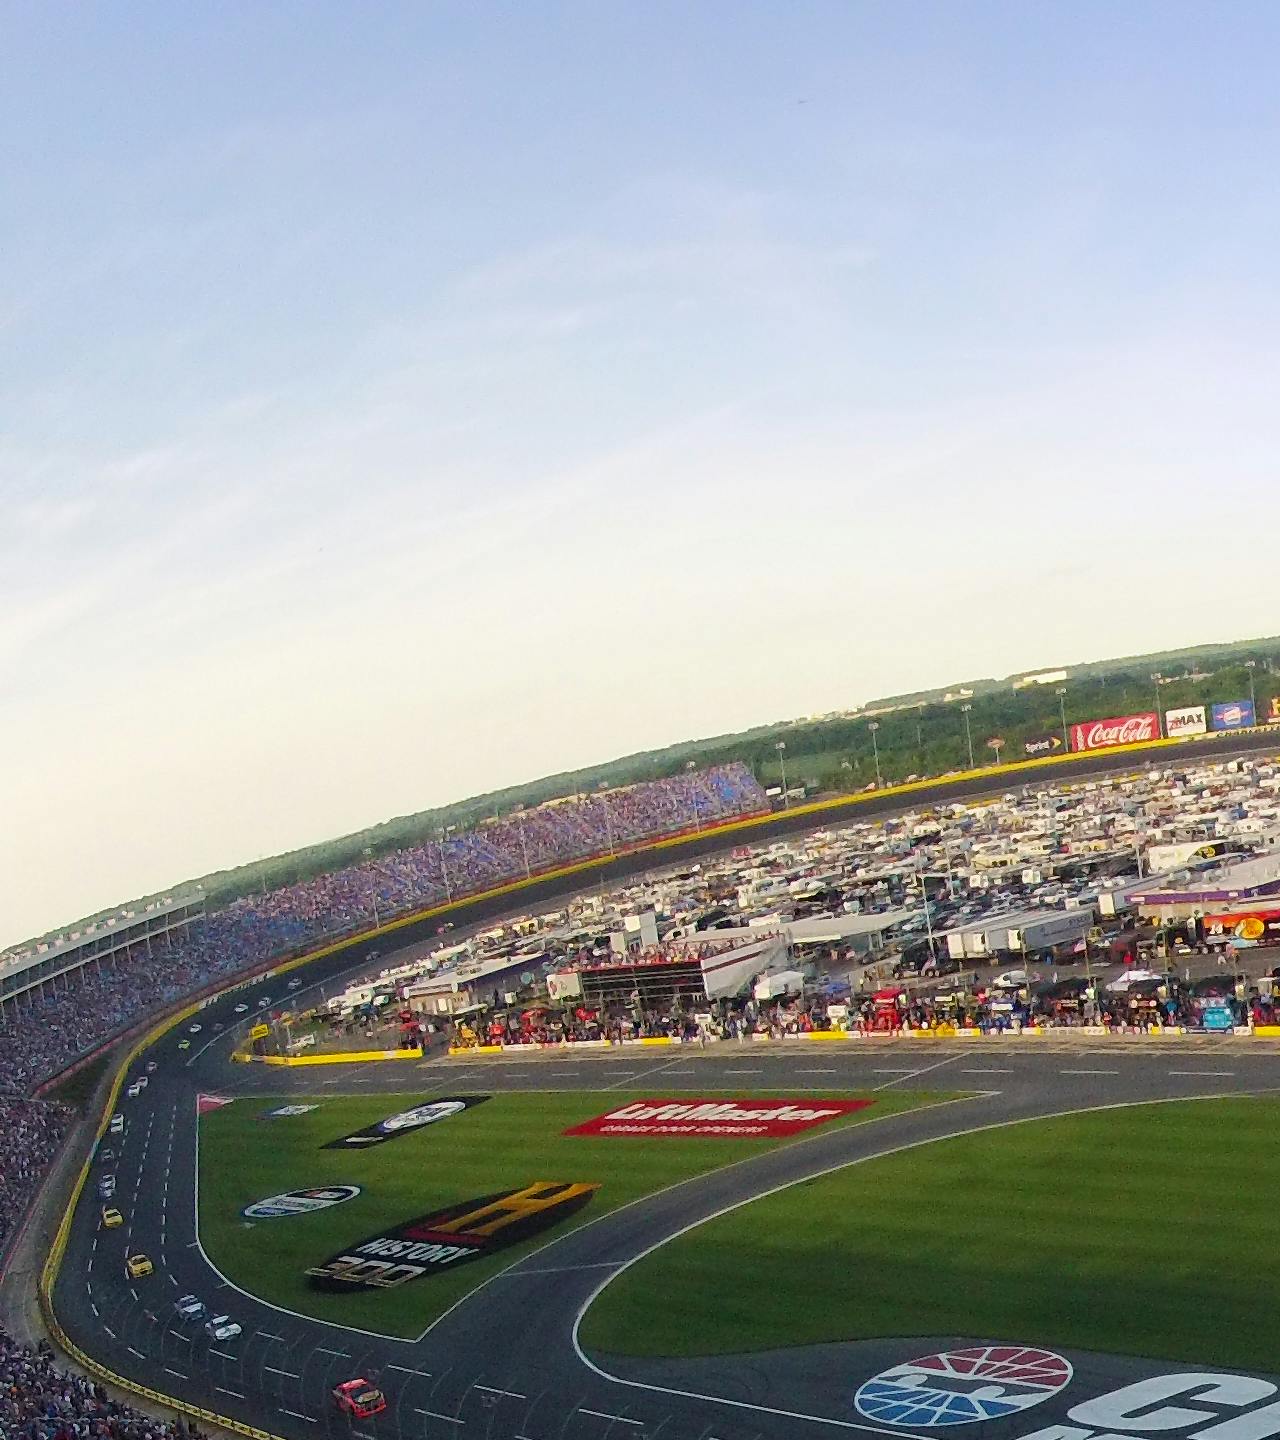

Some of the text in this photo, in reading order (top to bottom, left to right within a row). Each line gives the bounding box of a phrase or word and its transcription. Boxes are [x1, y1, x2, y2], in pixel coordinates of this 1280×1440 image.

[604, 1103, 843, 1121] LiftMaster
[355, 1237, 481, 1264] HISTORY
[303, 1255, 428, 1288] 300
